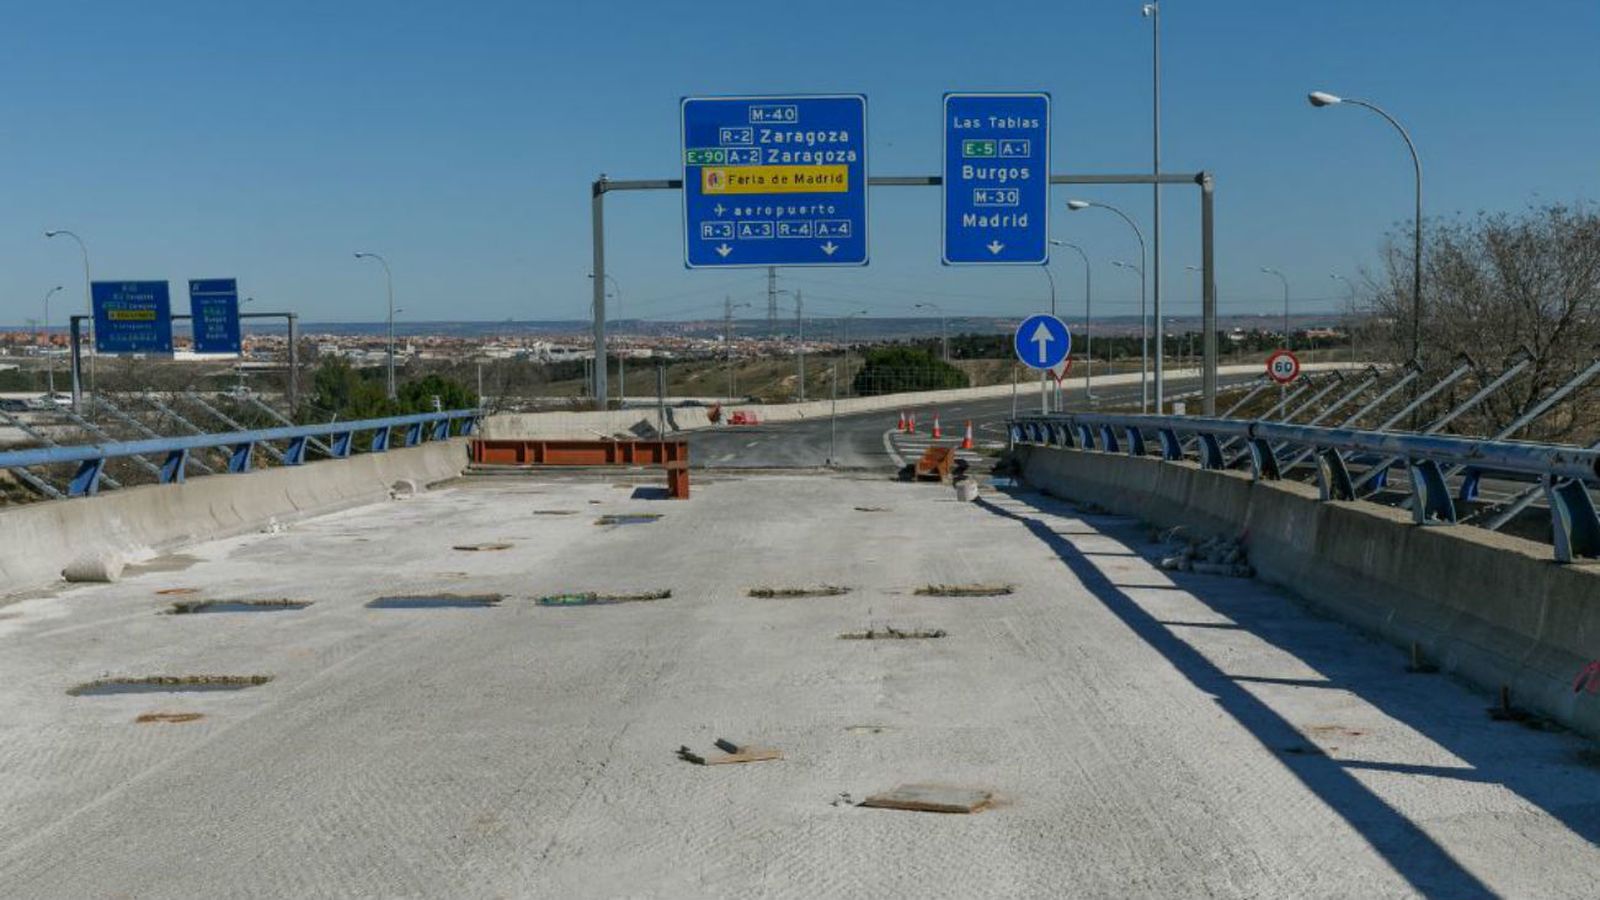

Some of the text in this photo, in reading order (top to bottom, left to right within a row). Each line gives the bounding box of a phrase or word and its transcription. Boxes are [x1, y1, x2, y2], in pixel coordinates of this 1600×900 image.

[751, 108, 795, 120] M-40
[953, 116, 1039, 129] Las Tablas
[722, 129, 849, 145] R-2 Zaragoza
[966, 143, 1028, 155] E-5 A-1
[687, 149, 857, 165] E-90 A-2 Zaragoza
[728, 172, 843, 185] Feria de Madrid
[962, 165, 1030, 183] Burgos
[975, 191, 1017, 203] M-30
[734, 204, 835, 217] aeropuerto
[963, 213, 1029, 228] Madrid
[703, 222, 848, 237] R-3 A-3 R-4 A-4
[1275, 361, 1293, 373] 60
